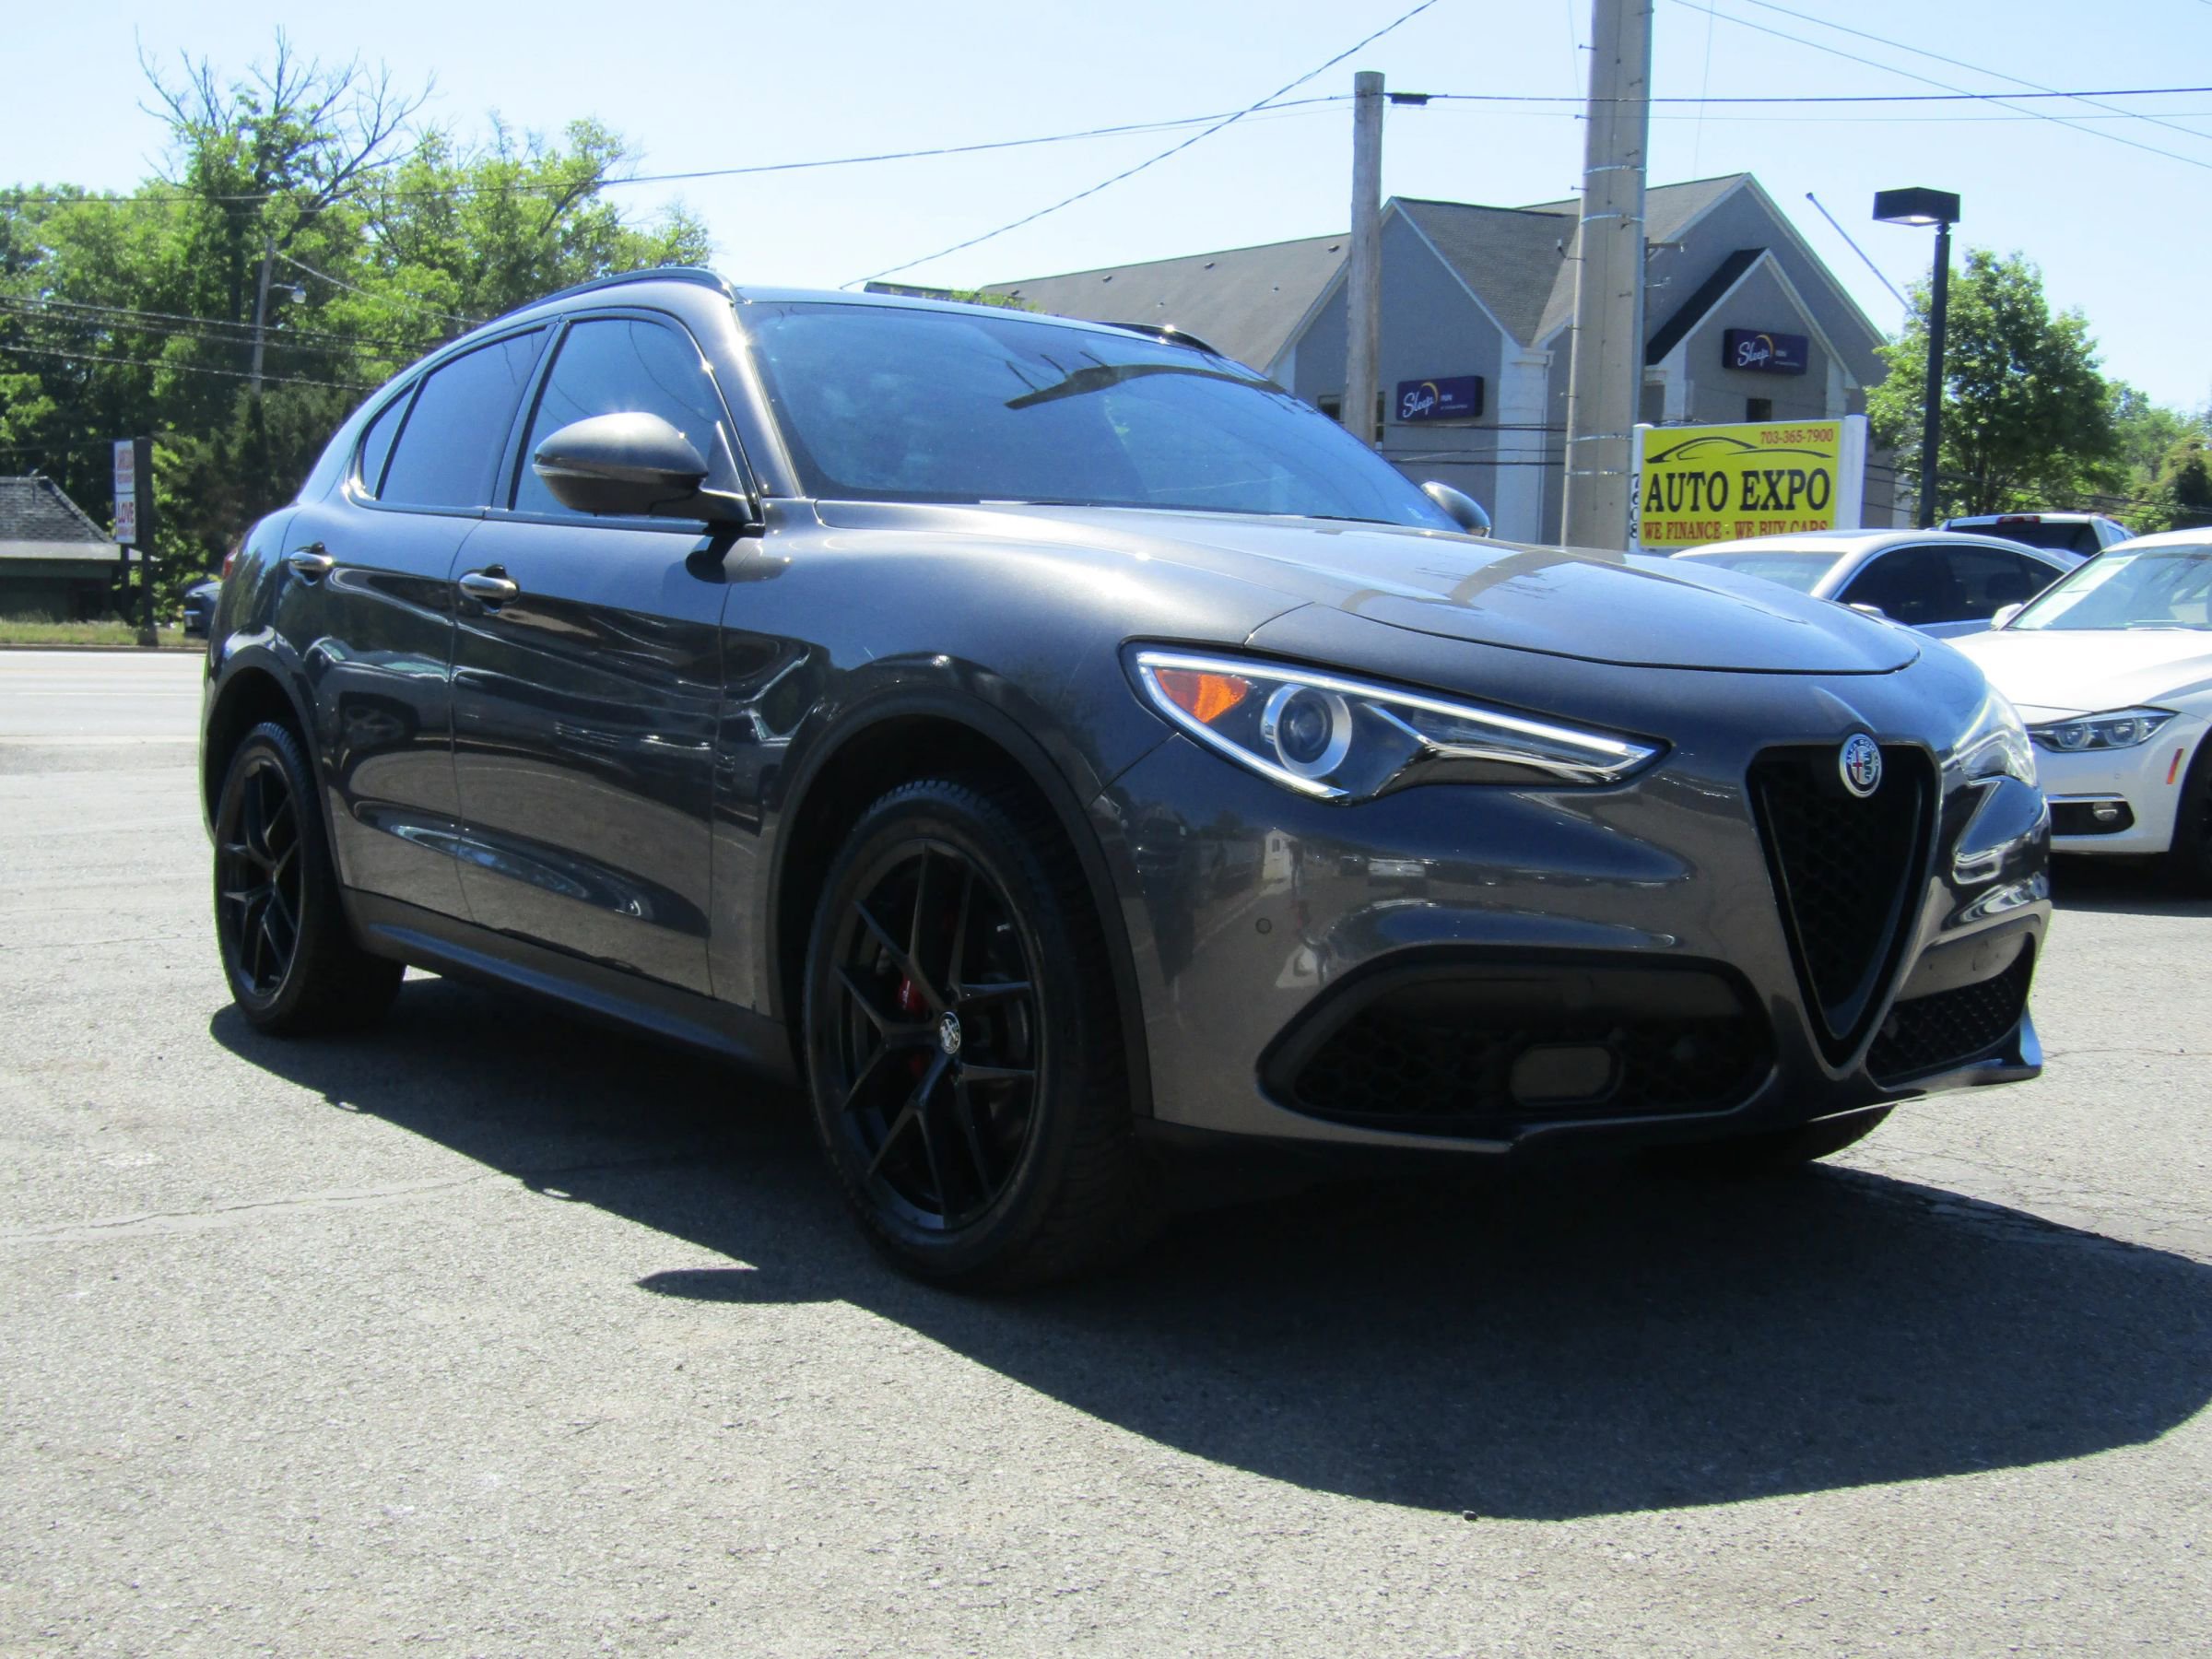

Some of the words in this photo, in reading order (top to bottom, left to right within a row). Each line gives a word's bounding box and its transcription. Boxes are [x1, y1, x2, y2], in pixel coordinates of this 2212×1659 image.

[1403, 391, 1435, 418] Sleep
[1760, 429, 1833, 444] 703-365-7900
[1644, 471, 1729, 512] AUTO
[1739, 467, 1830, 512] EXPO
[1644, 522, 1662, 540] WE
[1666, 521, 1722, 540] FINANCE
[1734, 521, 1755, 539] WE
[1759, 521, 1786, 535] BUY
